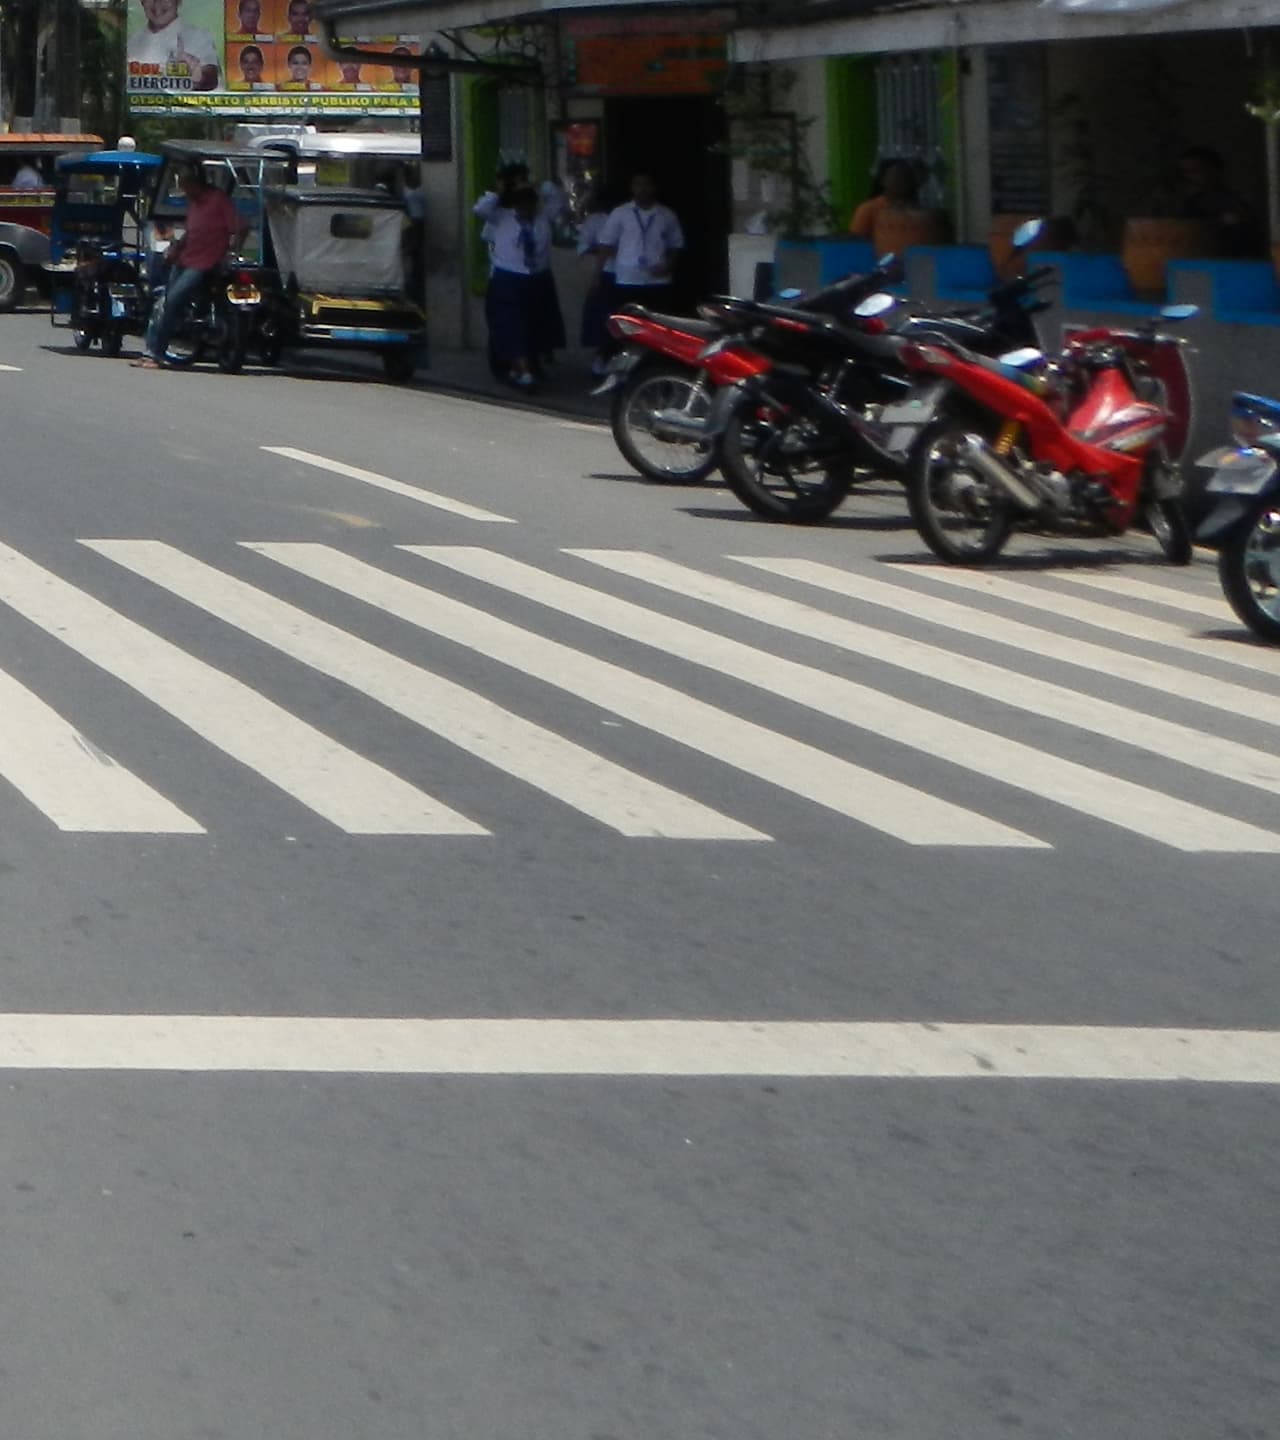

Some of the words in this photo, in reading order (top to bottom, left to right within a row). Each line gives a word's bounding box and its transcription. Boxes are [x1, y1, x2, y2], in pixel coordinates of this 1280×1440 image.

[130, 77, 191, 89] EJERCITO
[312, 97, 370, 106] PUBLIKO
[374, 97, 408, 106] PARA
